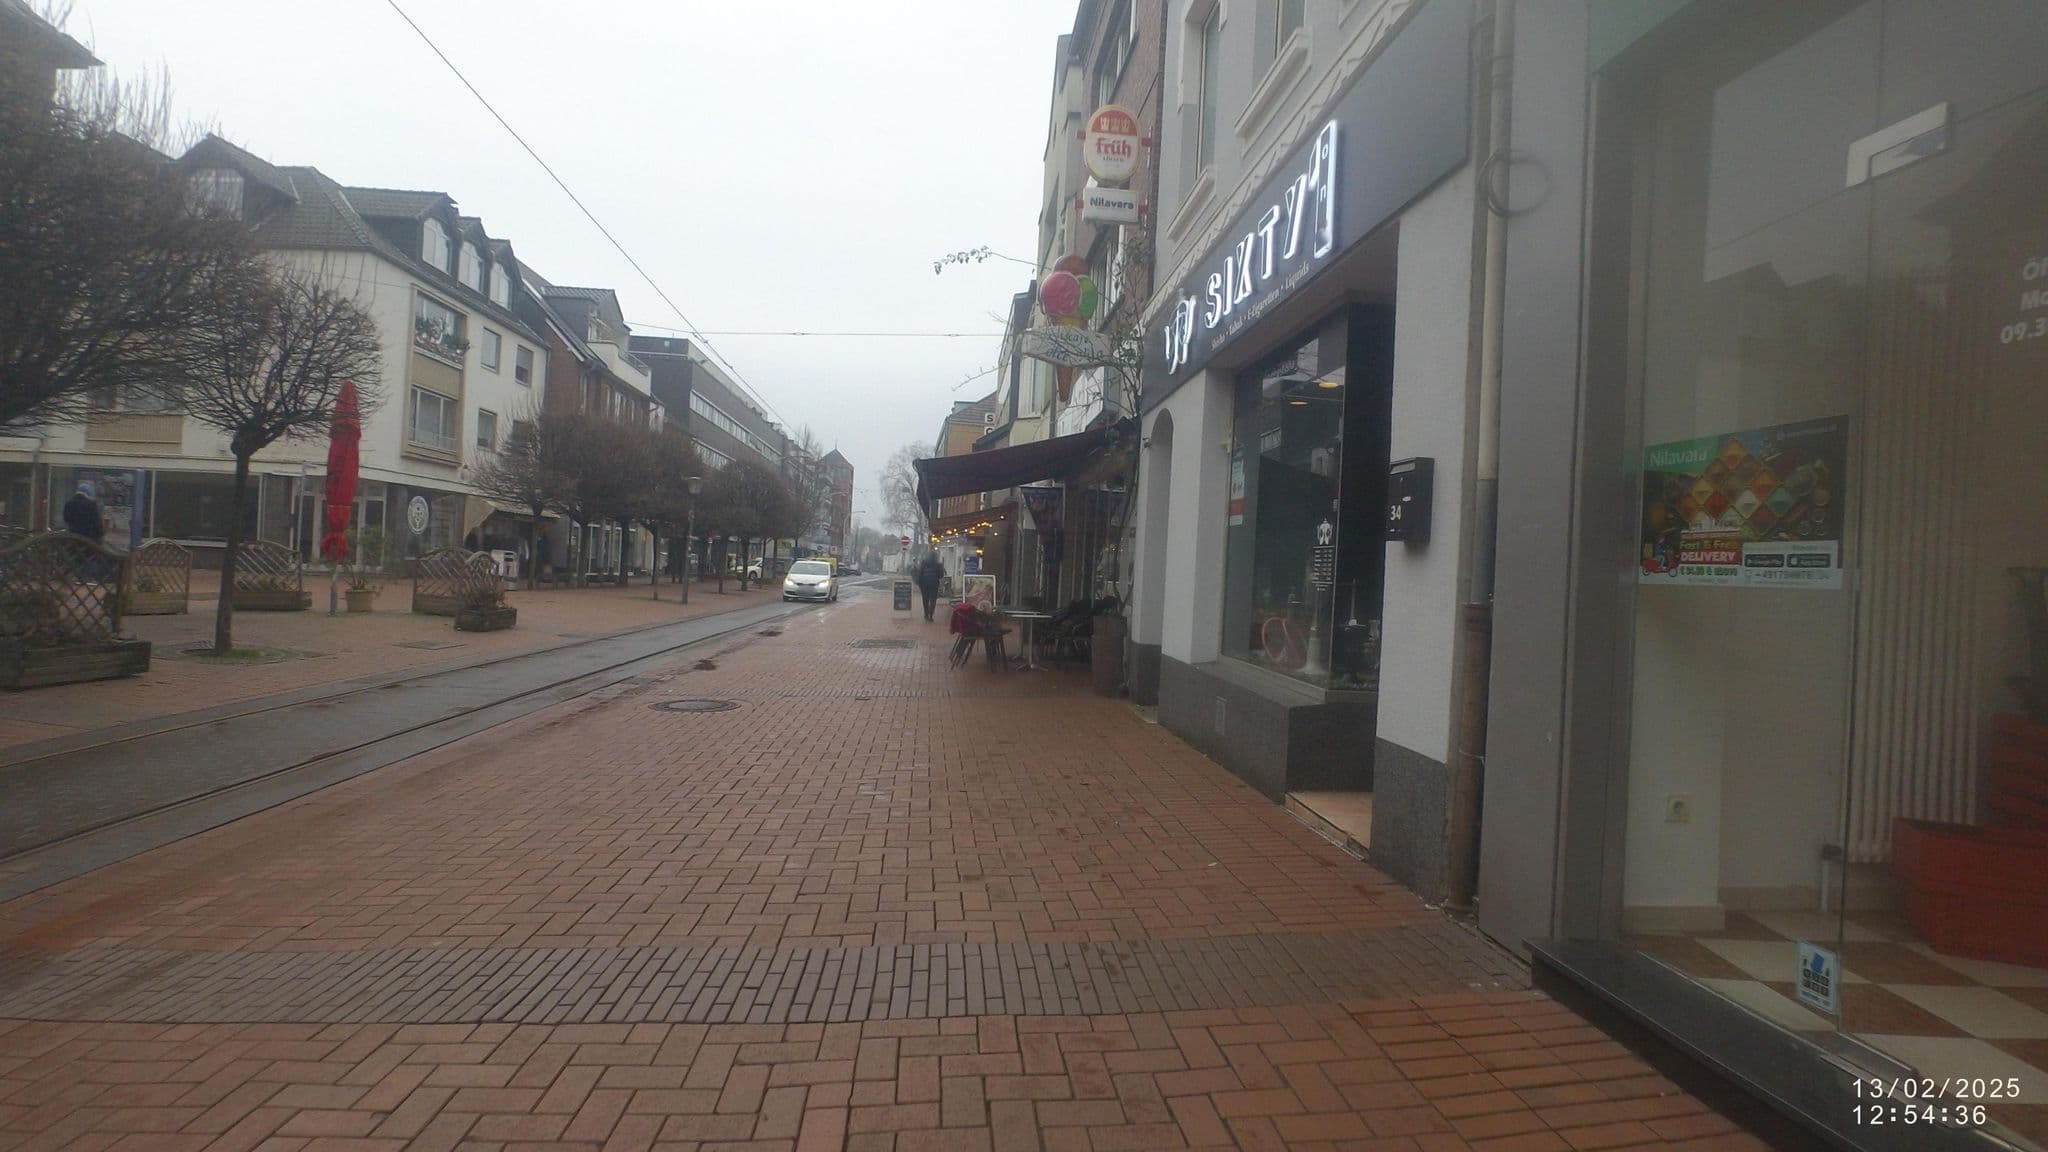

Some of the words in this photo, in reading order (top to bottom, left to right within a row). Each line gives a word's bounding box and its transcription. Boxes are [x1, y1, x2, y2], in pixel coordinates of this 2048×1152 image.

[1089, 196, 1134, 210] Nilavara
[1285, 261, 1309, 290] Liquids
[1390, 505, 1401, 521] 34
[1680, 551, 1736, 562] DELIVERY
